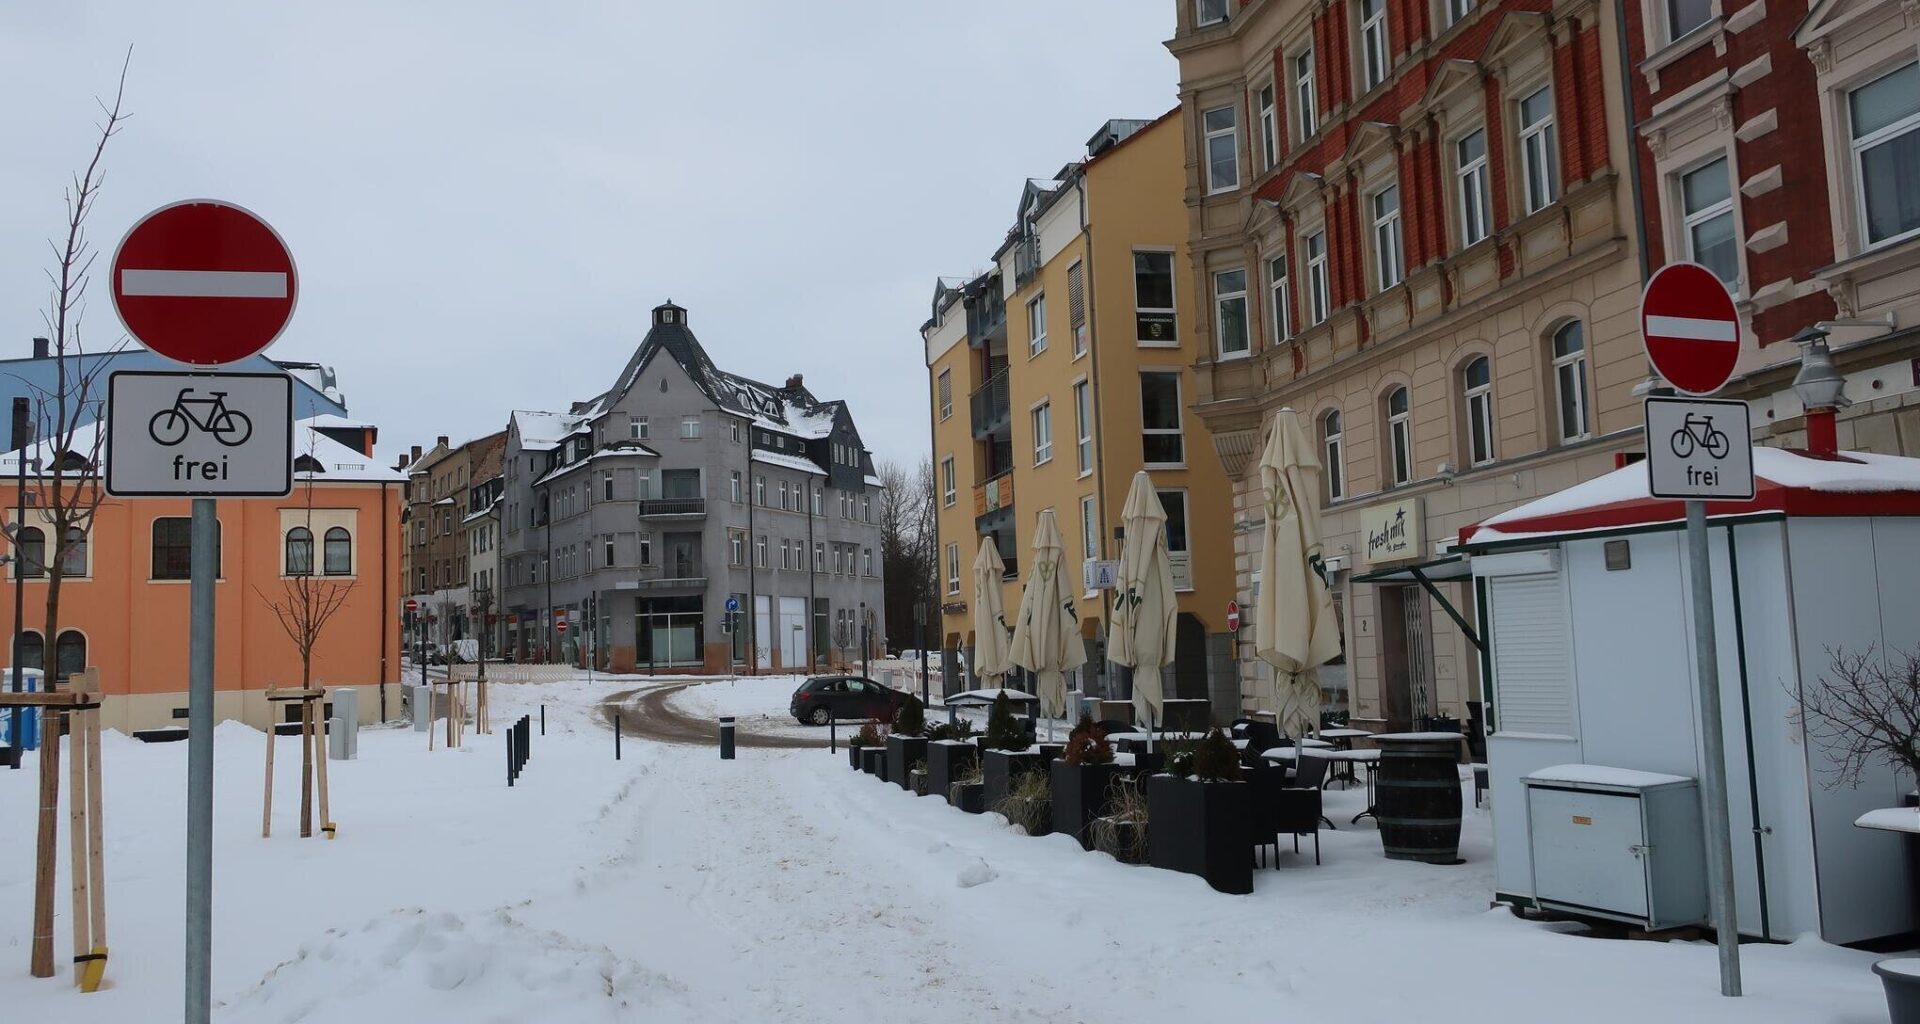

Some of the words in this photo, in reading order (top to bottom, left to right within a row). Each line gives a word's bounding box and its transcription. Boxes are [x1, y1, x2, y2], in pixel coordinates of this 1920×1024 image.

[173, 455, 228, 480] frei
[1687, 465, 1719, 486] frei
[1368, 520, 1389, 560] fresh
[1390, 519, 1405, 541] mix
[1362, 619, 1368, 632] 2
